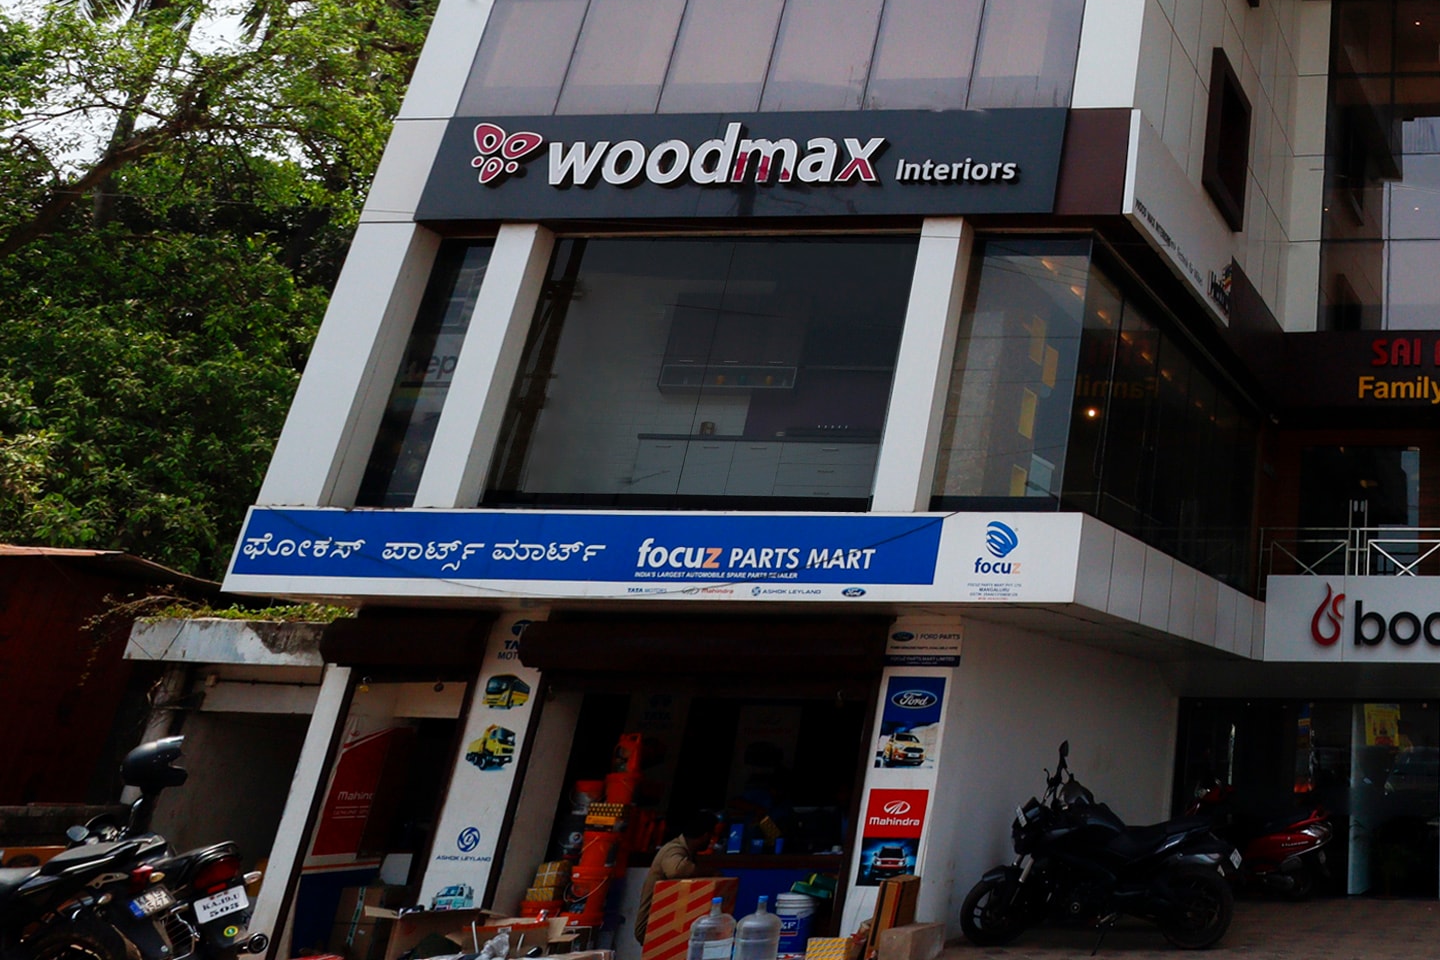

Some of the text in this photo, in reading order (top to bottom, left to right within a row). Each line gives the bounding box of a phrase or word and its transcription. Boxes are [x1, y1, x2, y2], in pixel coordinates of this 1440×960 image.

[549, 122, 1018, 185] woodmax Interiors
[1371, 337, 1422, 367] SAI
[637, 538, 877, 570] focuz PARTS MART
[974, 557, 1022, 574] focuz
[657, 571, 685, 579] LARGEST
[504, 640, 520, 649] TA
[900, 692, 929, 706] Ford
[869, 816, 920, 827] Mahindra
